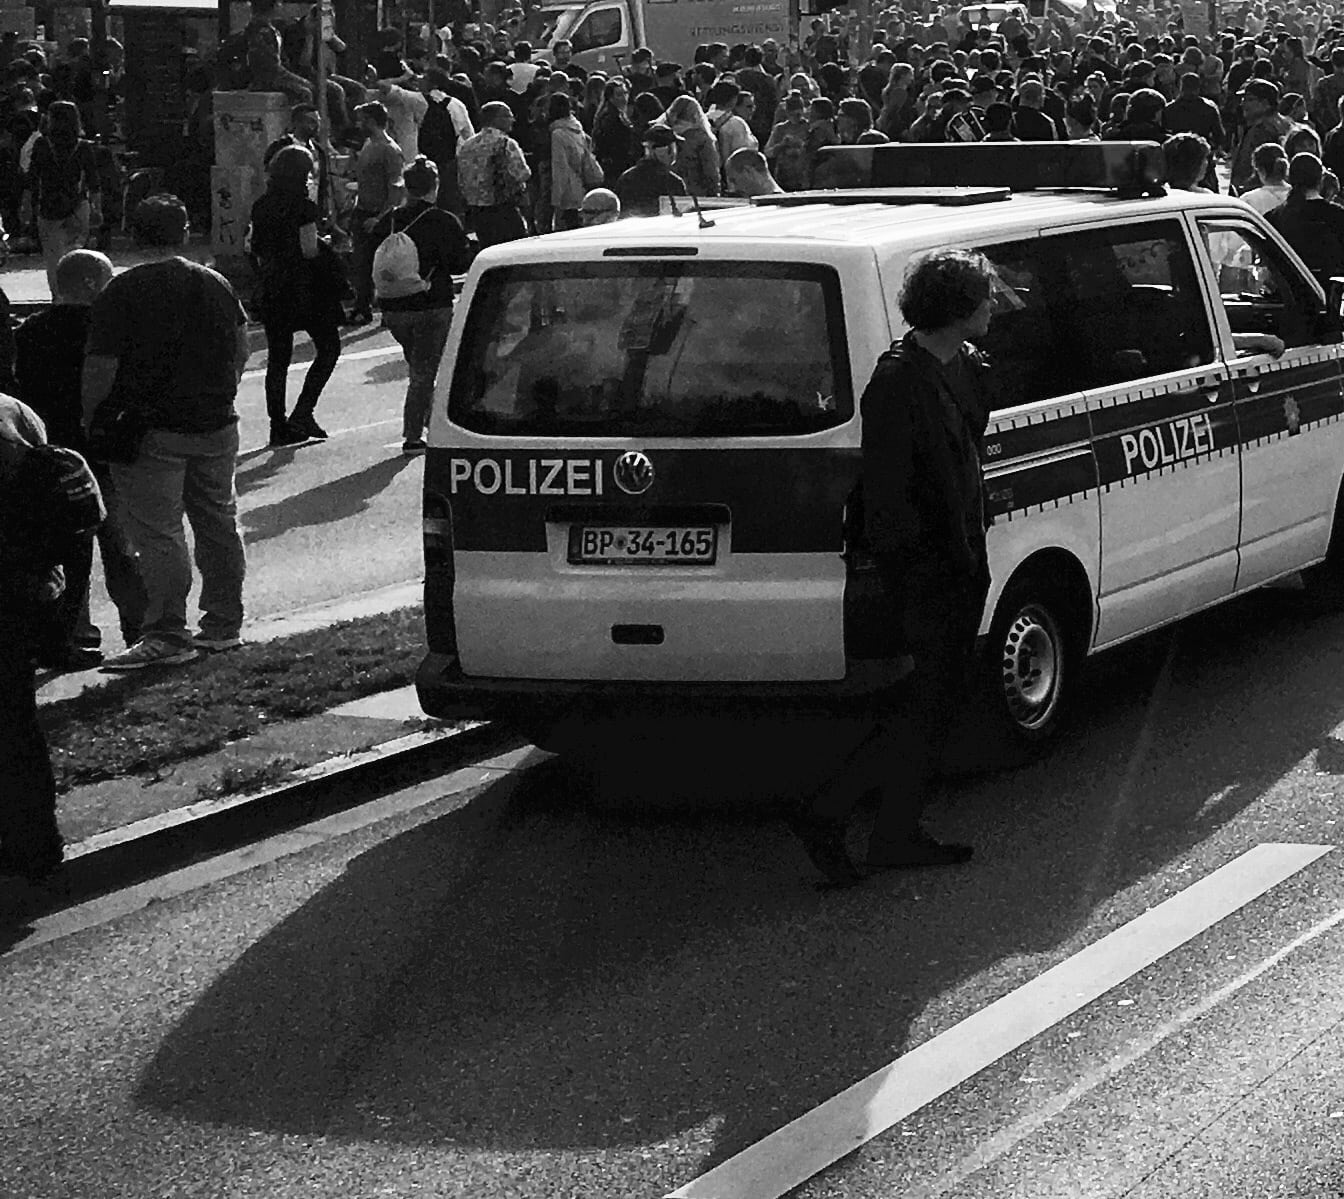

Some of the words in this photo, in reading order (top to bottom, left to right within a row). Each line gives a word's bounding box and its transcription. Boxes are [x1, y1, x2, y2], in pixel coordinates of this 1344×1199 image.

[1120, 413, 1216, 475] POLIZEI
[450, 458, 603, 495] POLIZEI
[583, 530, 614, 556] BP
[626, 530, 711, 556] 34-165
